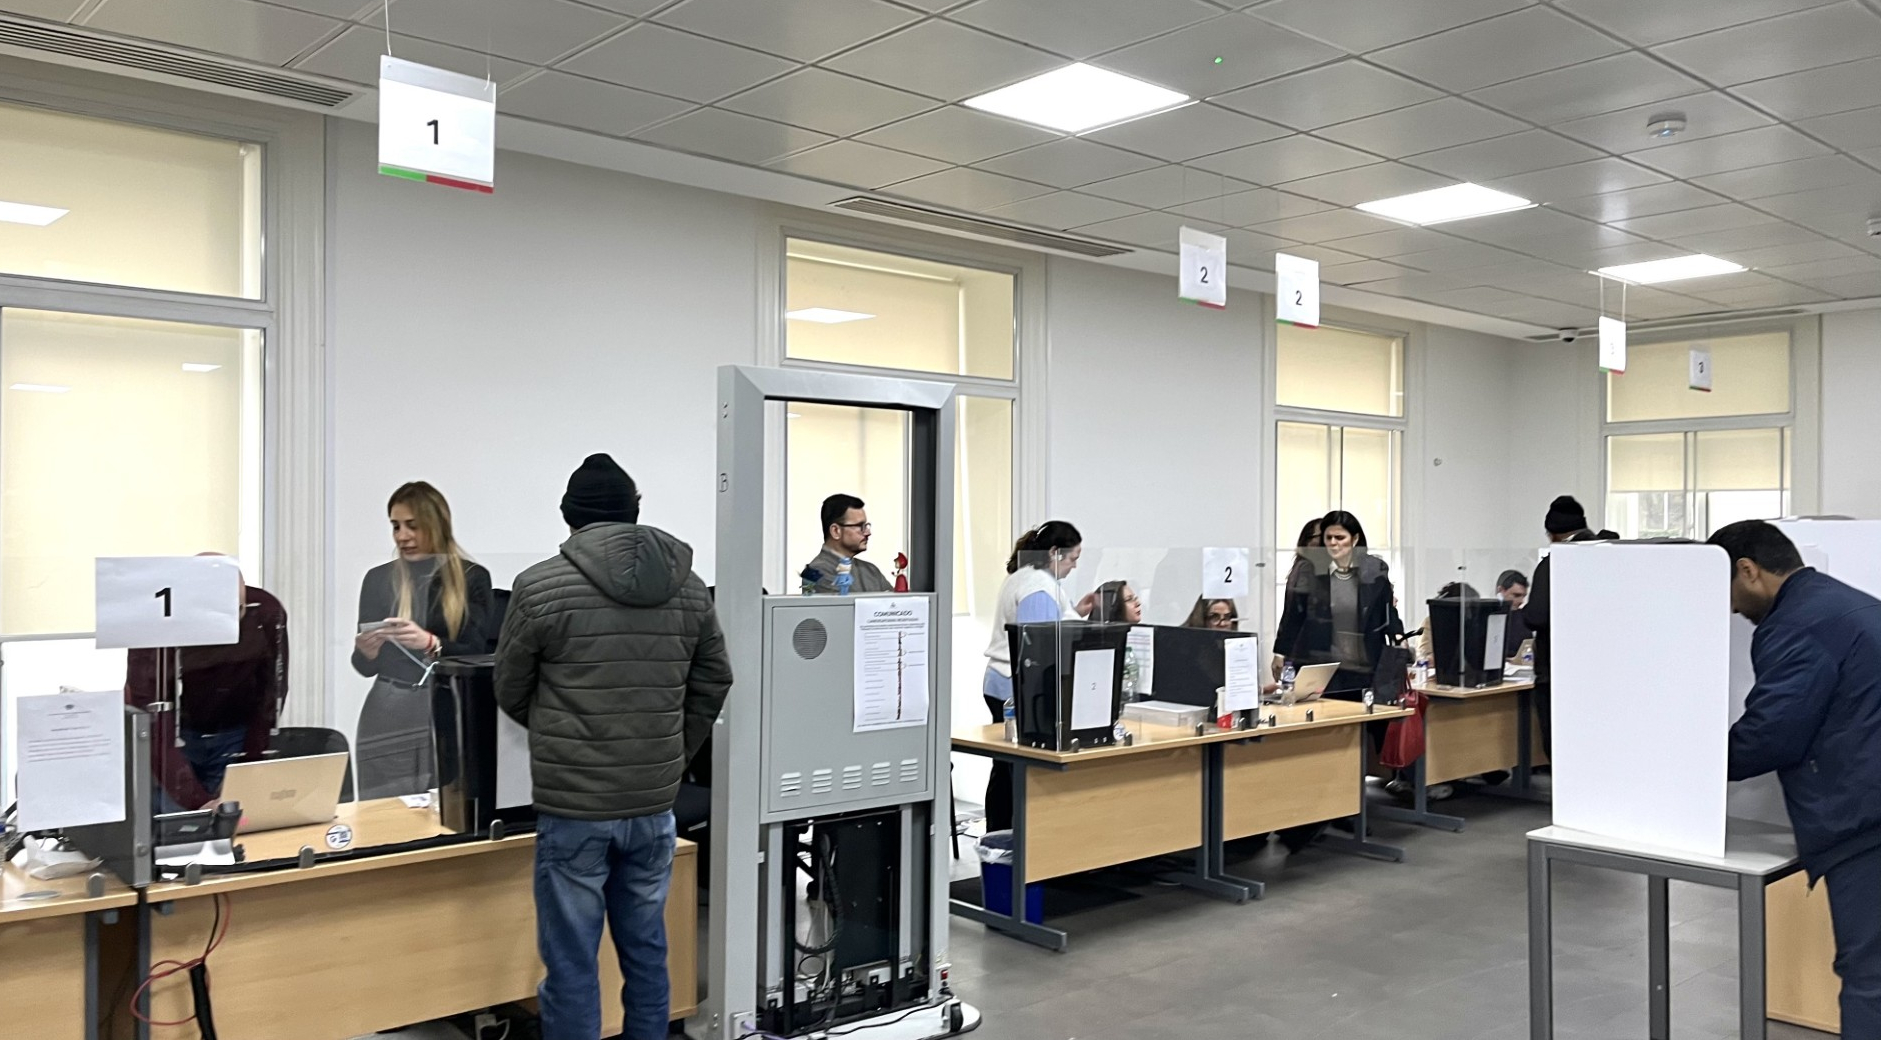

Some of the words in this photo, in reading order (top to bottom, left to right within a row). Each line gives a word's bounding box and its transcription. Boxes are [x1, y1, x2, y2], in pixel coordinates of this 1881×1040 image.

[427, 119, 439, 145] 1
[1200, 266, 1208, 284] 2
[1295, 290, 1302, 306] 2
[1224, 566, 1232, 583] 2
[155, 587, 171, 617] 1
[1091, 682, 1097, 691] 2
